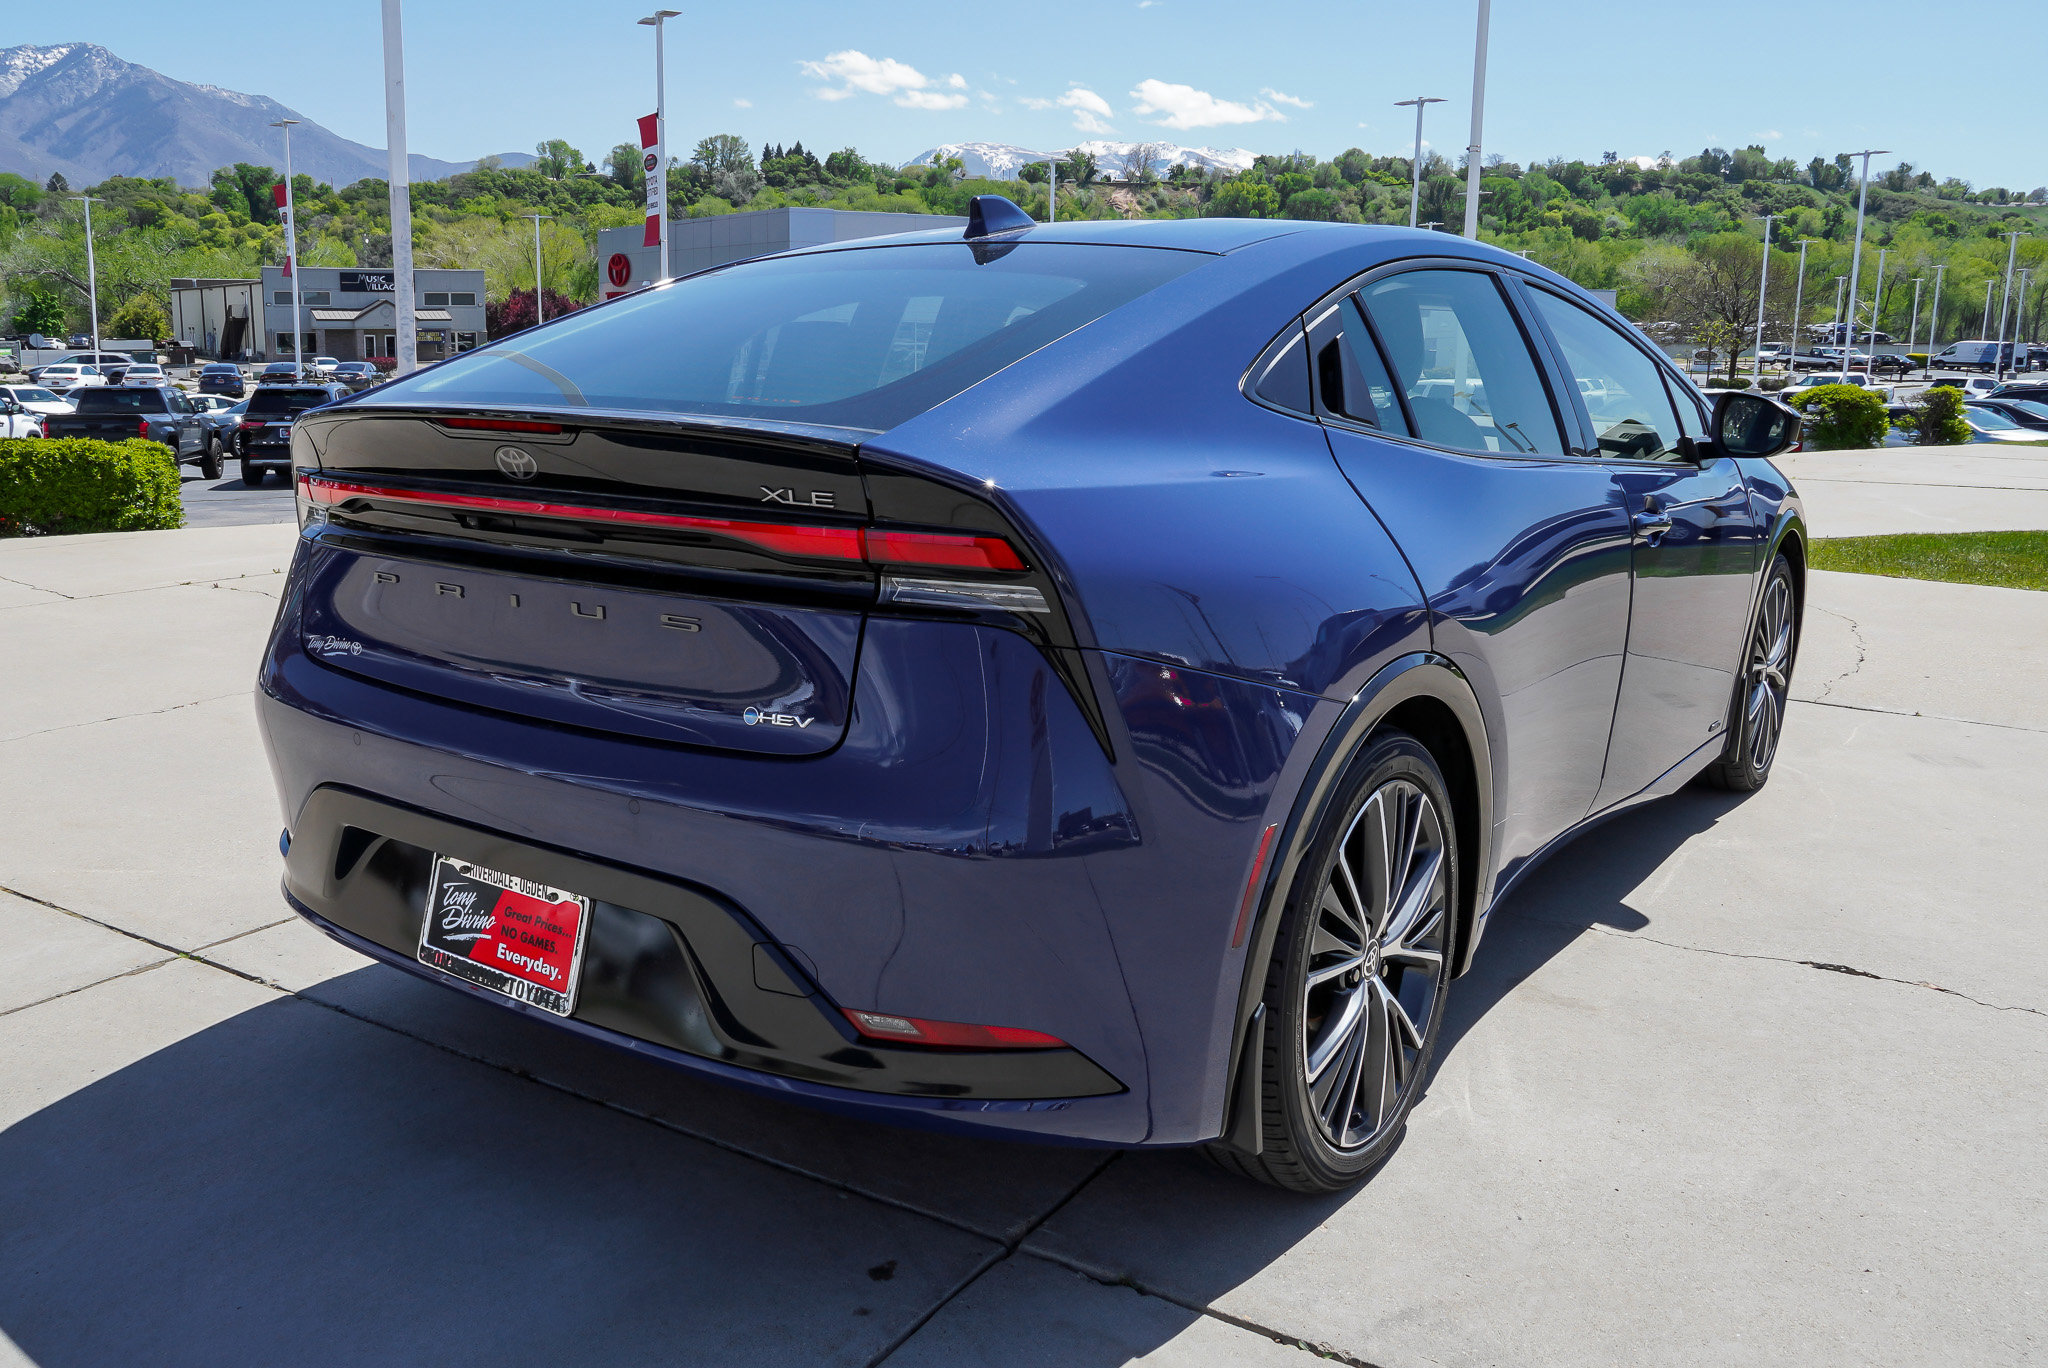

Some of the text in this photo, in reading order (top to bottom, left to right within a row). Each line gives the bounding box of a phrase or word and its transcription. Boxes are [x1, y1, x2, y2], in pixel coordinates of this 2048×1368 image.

[760, 486, 835, 508] XLE
[373, 570, 702, 633] PRIUS
[308, 635, 351, 653] Tony Divino
[759, 712, 815, 729] HEV
[470, 863, 548, 900] RIVERDALE OGDEN
[443, 882, 478, 911] Tony
[439, 905, 497, 930] Divino
[504, 906, 573, 938] Great Prices...
[500, 924, 558, 954] NO GAMES.
[496, 942, 562, 982] Everyday.
